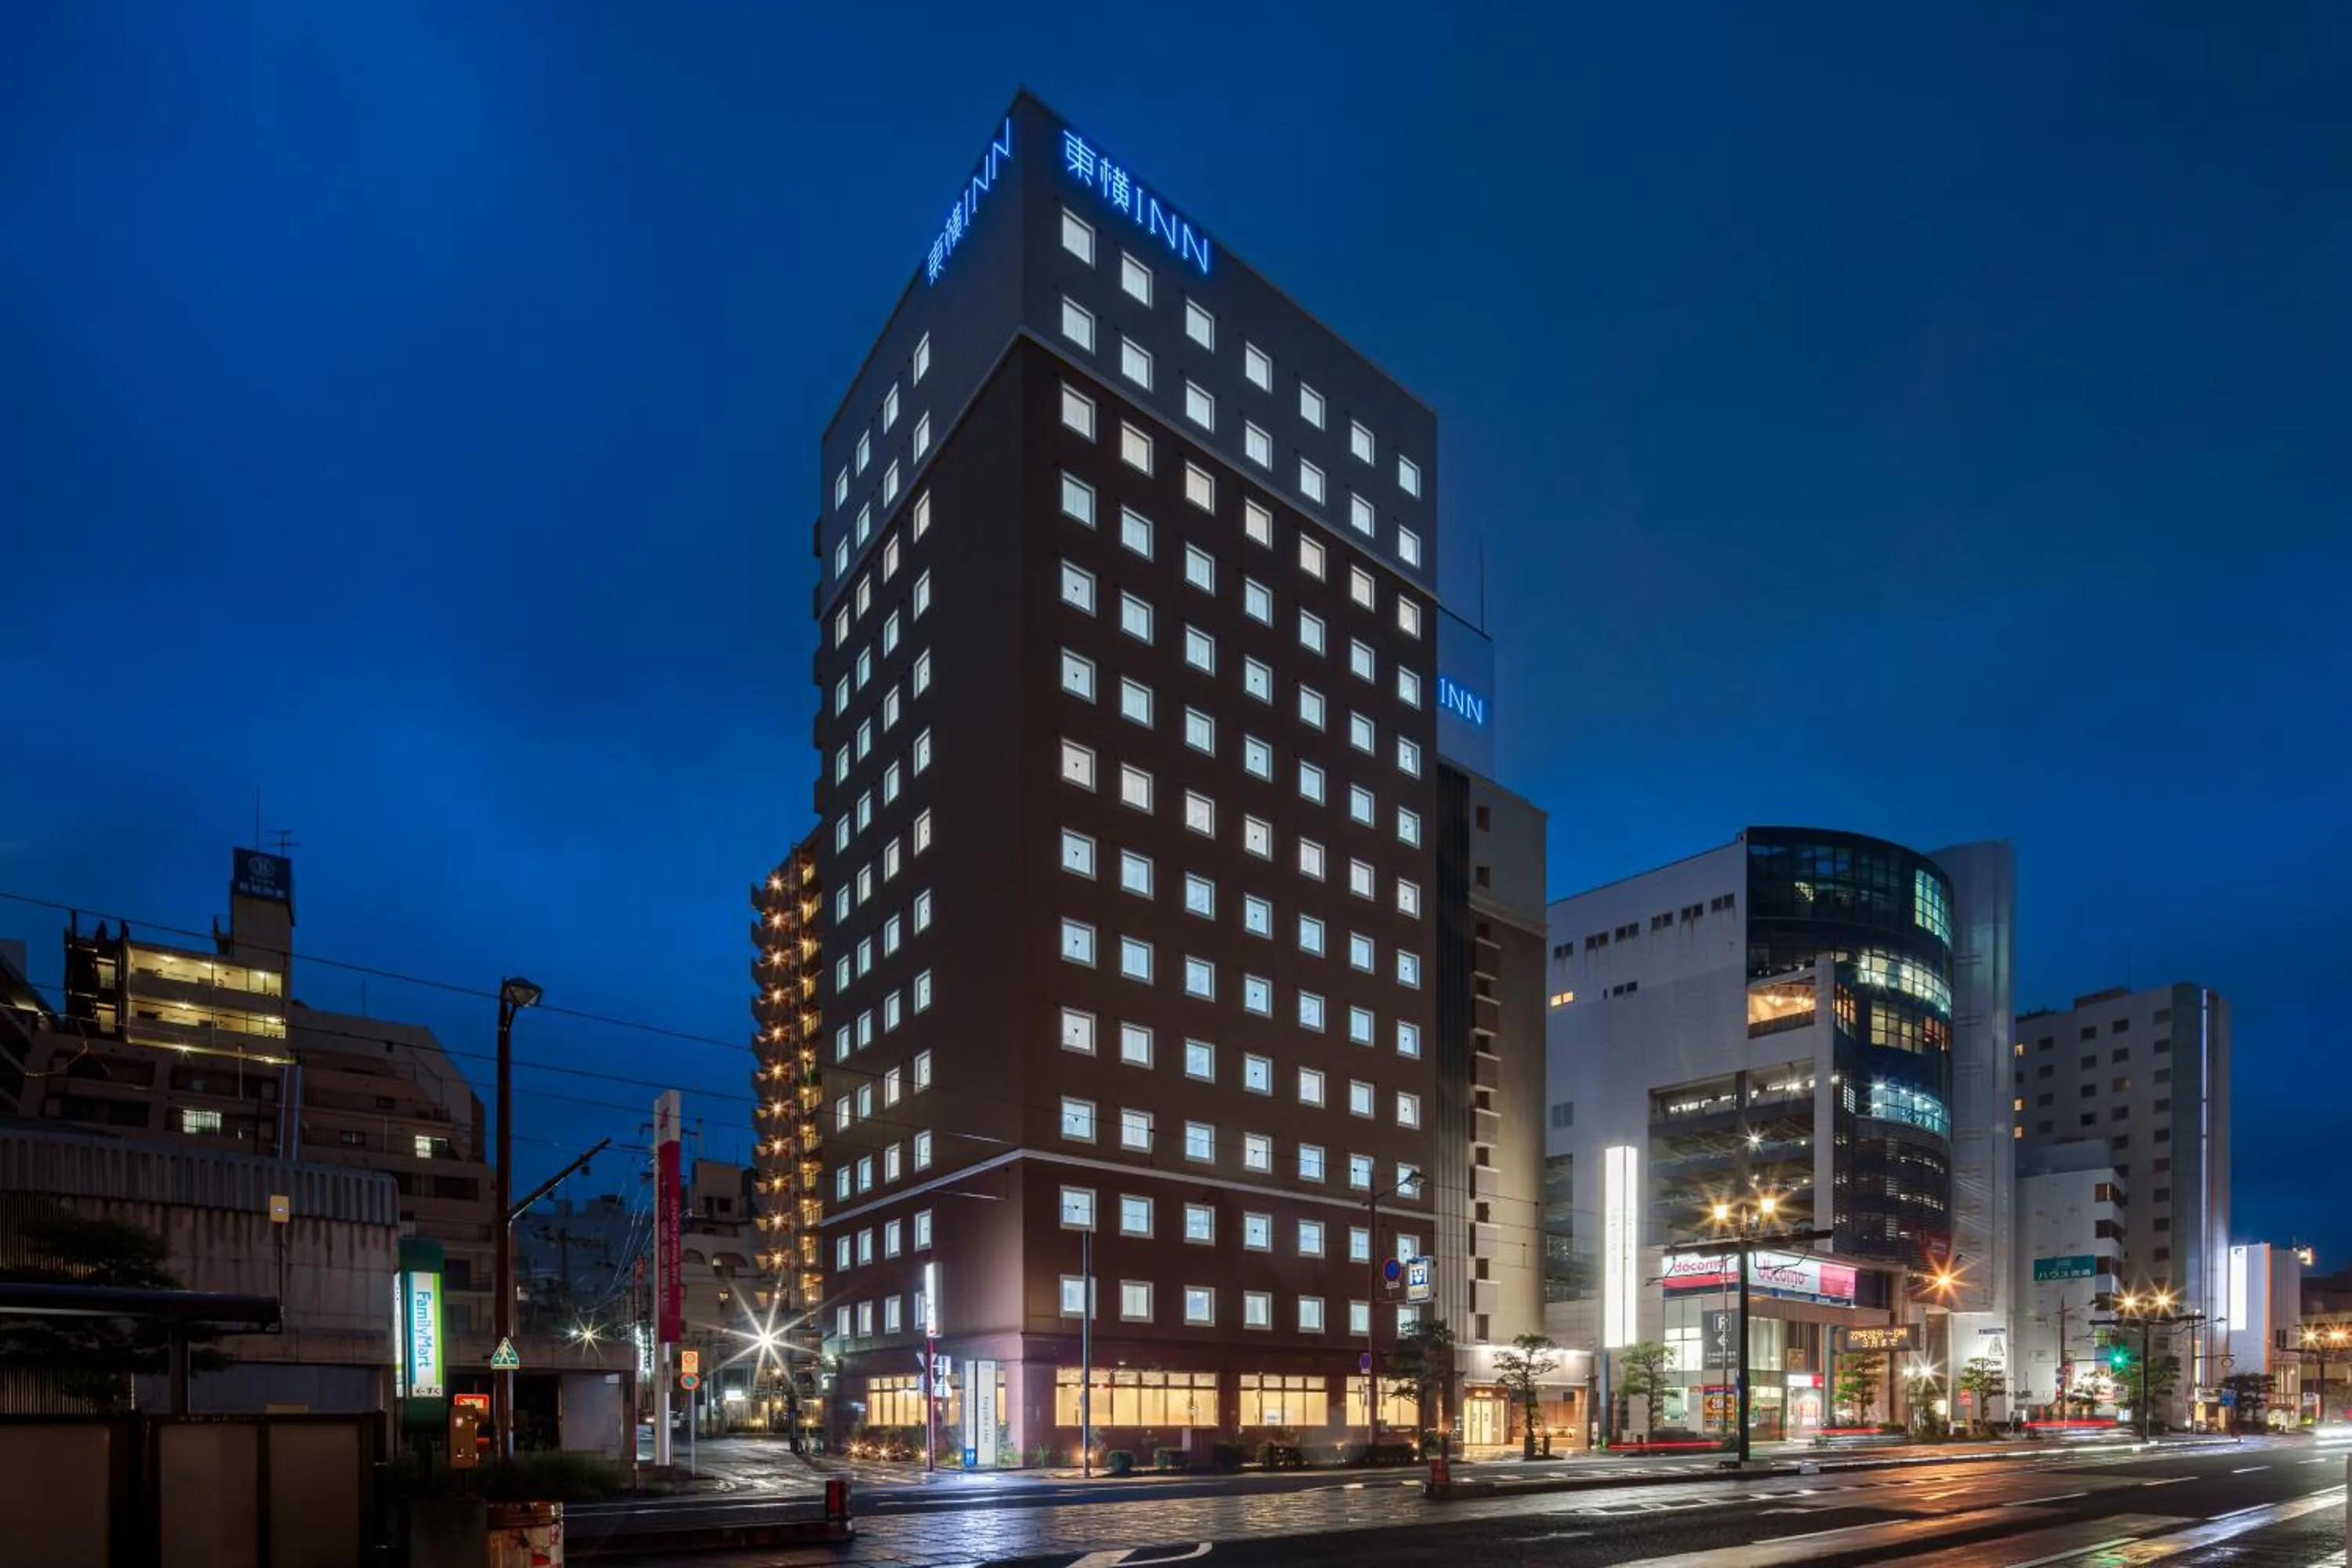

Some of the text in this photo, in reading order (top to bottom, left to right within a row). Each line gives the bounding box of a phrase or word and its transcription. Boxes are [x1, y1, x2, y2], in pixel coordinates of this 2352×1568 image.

[928, 117, 1011, 286] 東横INN
[1063, 129, 1209, 274] 東横INN
[1439, 678, 1483, 724] INN
[416, 1291, 434, 1368] FamilyMart
